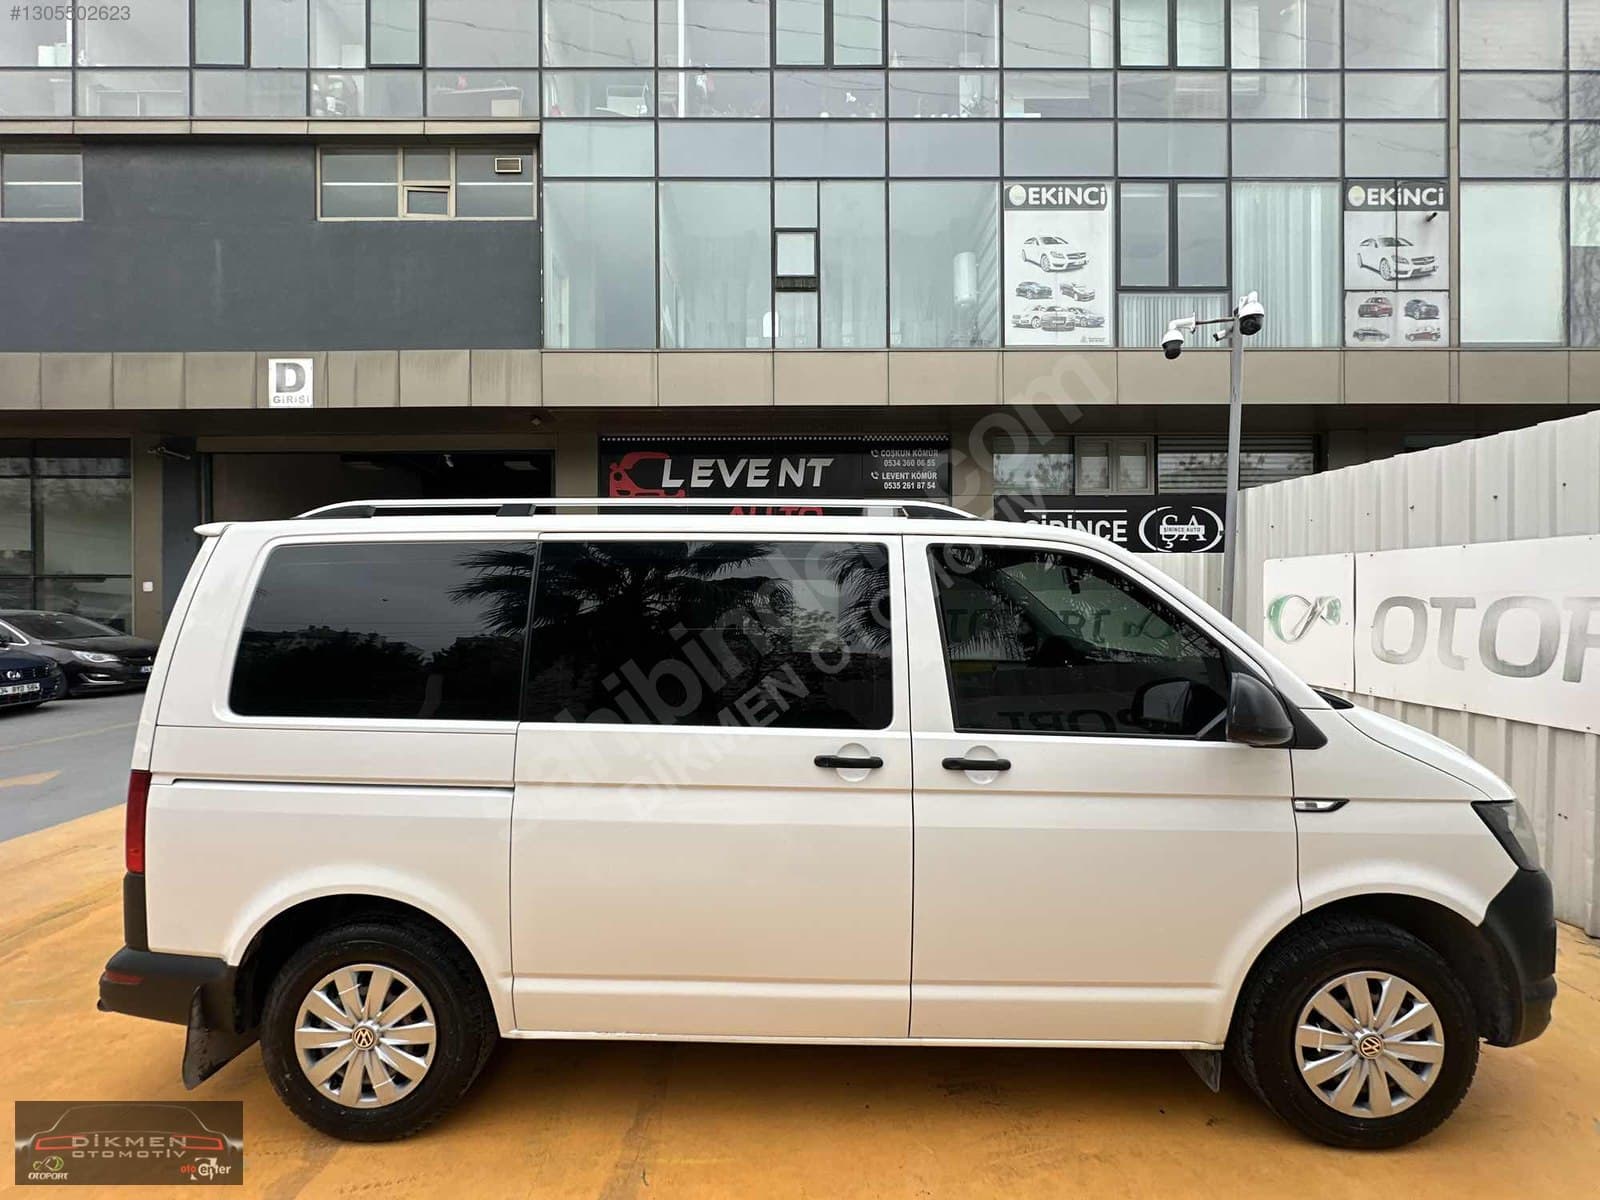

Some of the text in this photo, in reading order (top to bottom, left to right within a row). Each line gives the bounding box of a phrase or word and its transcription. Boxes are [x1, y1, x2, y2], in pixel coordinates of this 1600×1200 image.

[275, 362, 306, 393] D
[661, 457, 835, 488] LEVENT
[881, 472, 910, 480] LEVENT
[1026, 515, 1128, 541] İNCE
